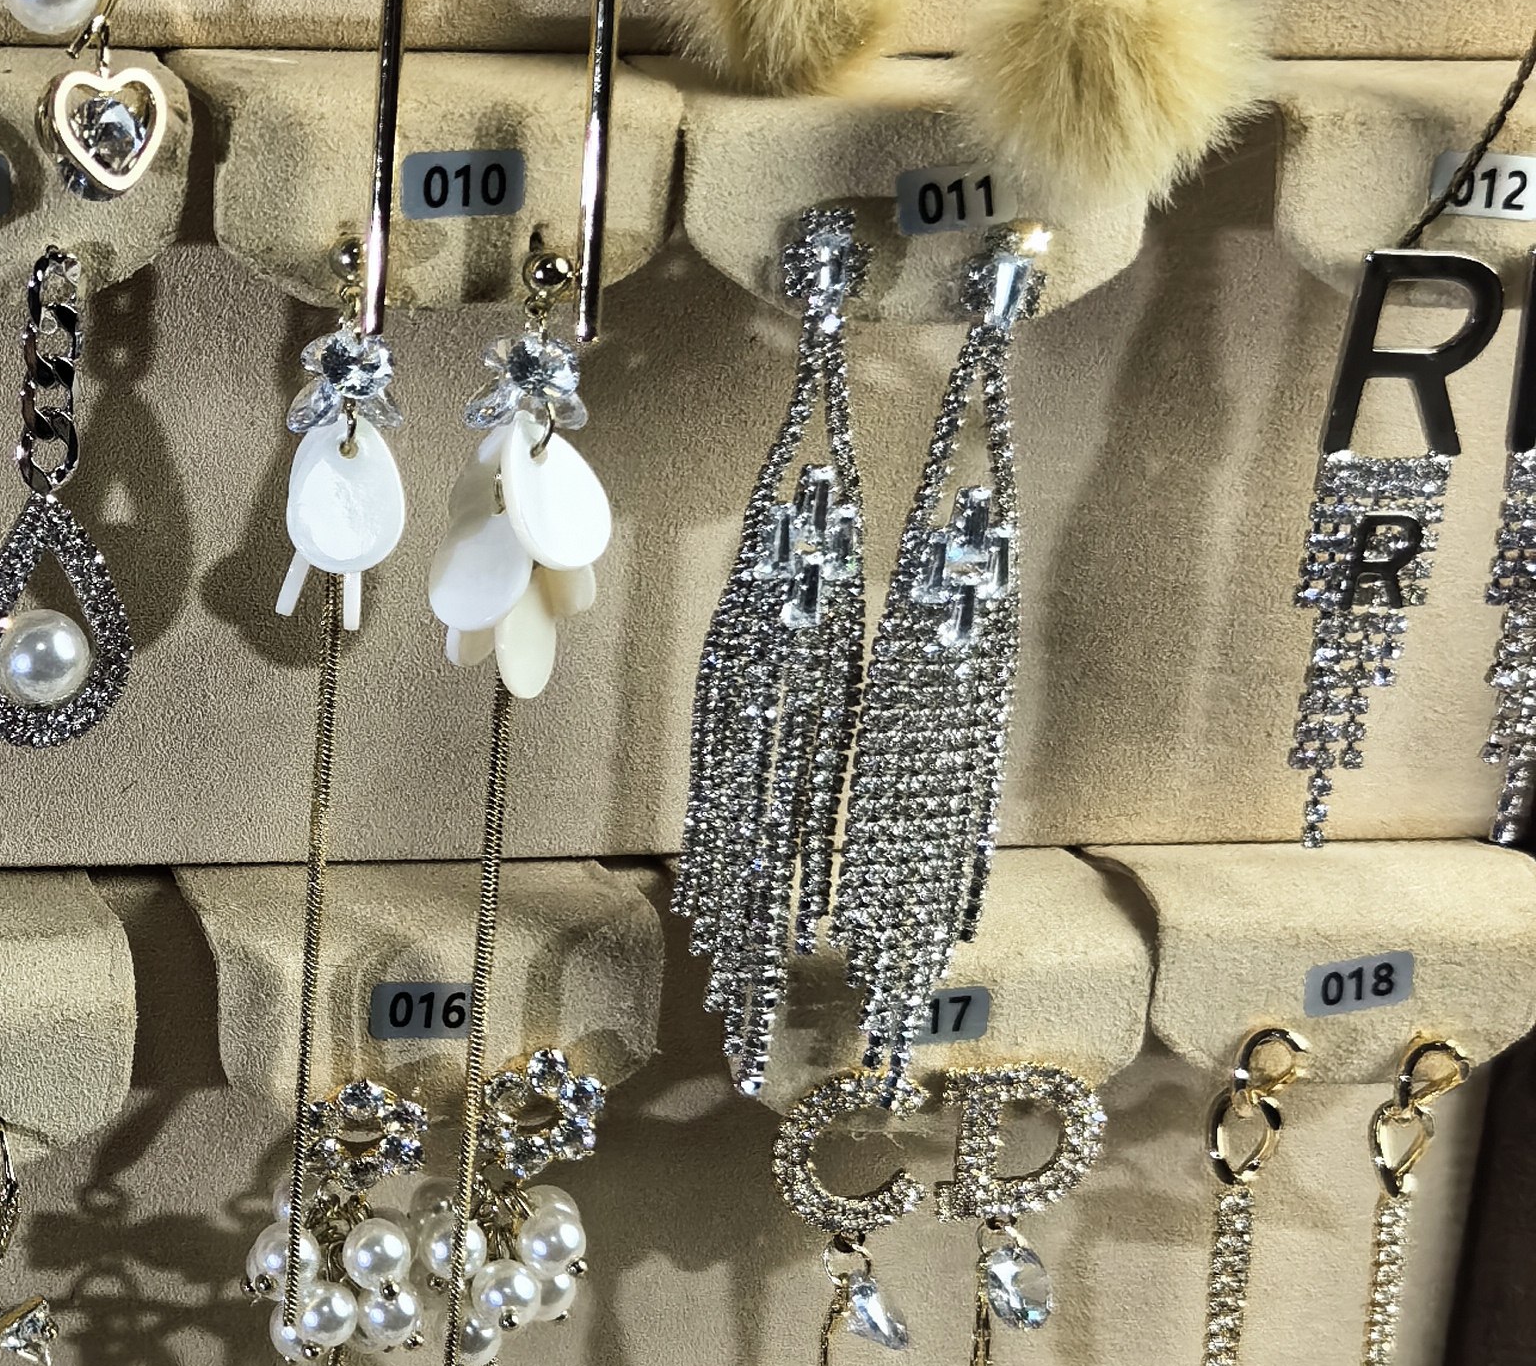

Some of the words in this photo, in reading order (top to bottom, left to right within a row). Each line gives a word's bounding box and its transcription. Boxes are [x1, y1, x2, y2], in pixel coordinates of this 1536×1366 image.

[422, 163, 507, 209] 010
[918, 175, 994, 224] 011
[1322, 962, 1395, 1006] 018
[388, 990, 467, 1030] 016
[929, 995, 972, 1034] 17
